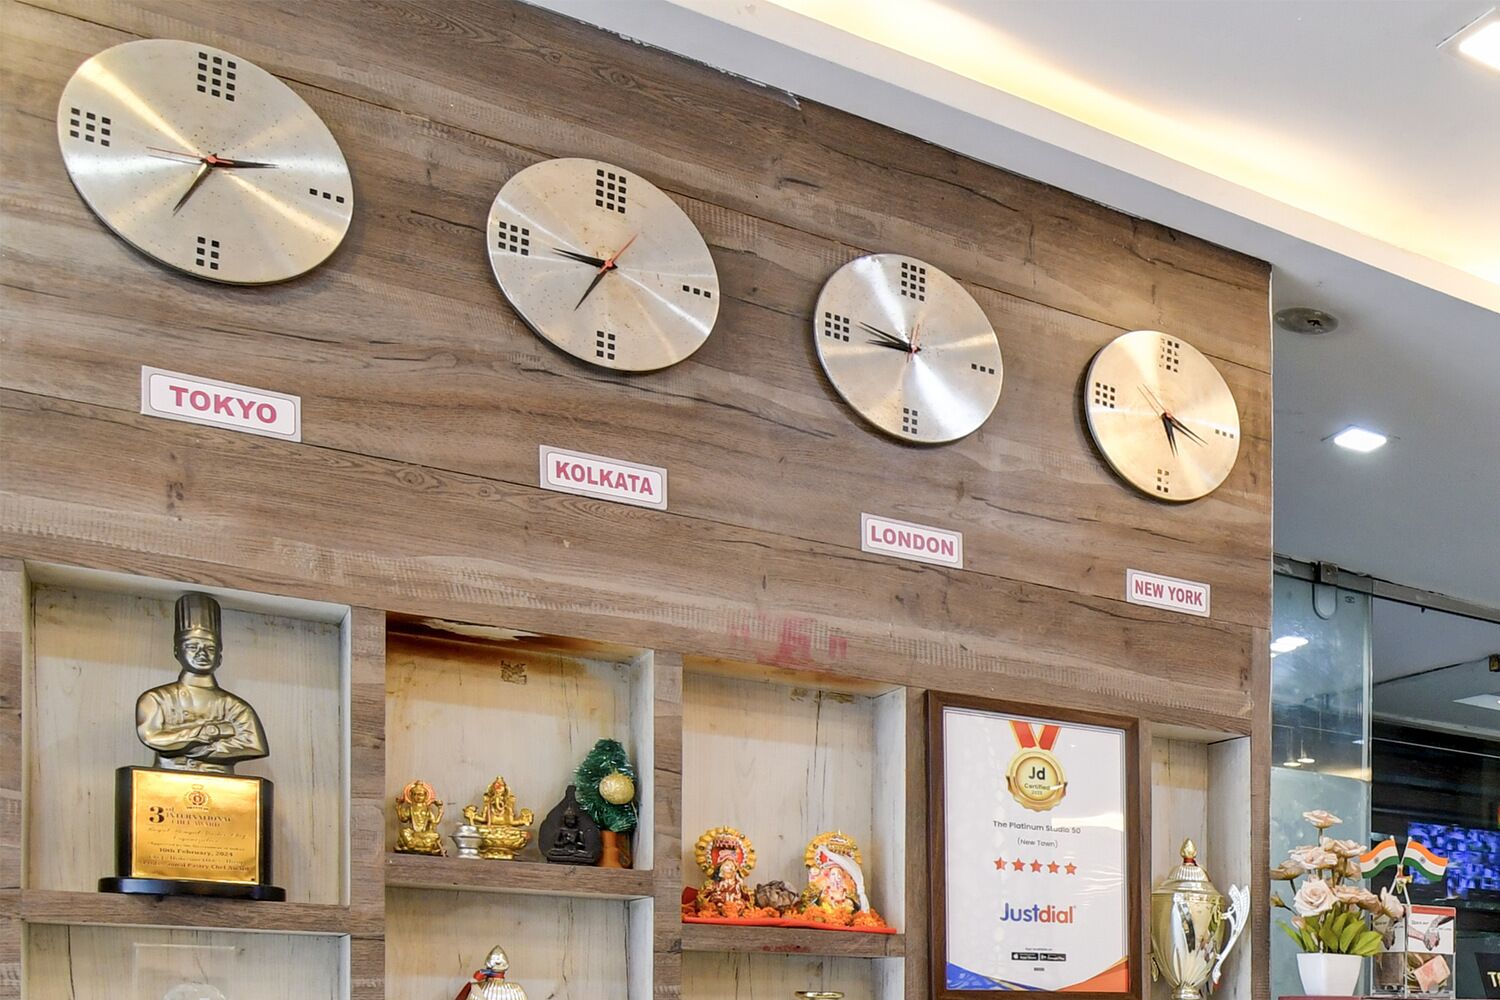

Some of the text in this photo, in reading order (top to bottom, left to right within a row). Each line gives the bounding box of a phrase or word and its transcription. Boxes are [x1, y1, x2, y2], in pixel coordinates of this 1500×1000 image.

[169, 385, 277, 424] TOKYO
[555, 460, 653, 495] KOLKATA
[871, 525, 954, 557] LONDON
[1135, 579, 1203, 607] NEW YORK
[1028, 766, 1046, 780] Jd
[1024, 783, 1051, 791] Certified
[993, 820, 1008, 828] The
[1009, 822, 1045, 832] Platinum
[1017, 837, 1059, 848] (New Town)
[999, 902, 1073, 924] Justdial
